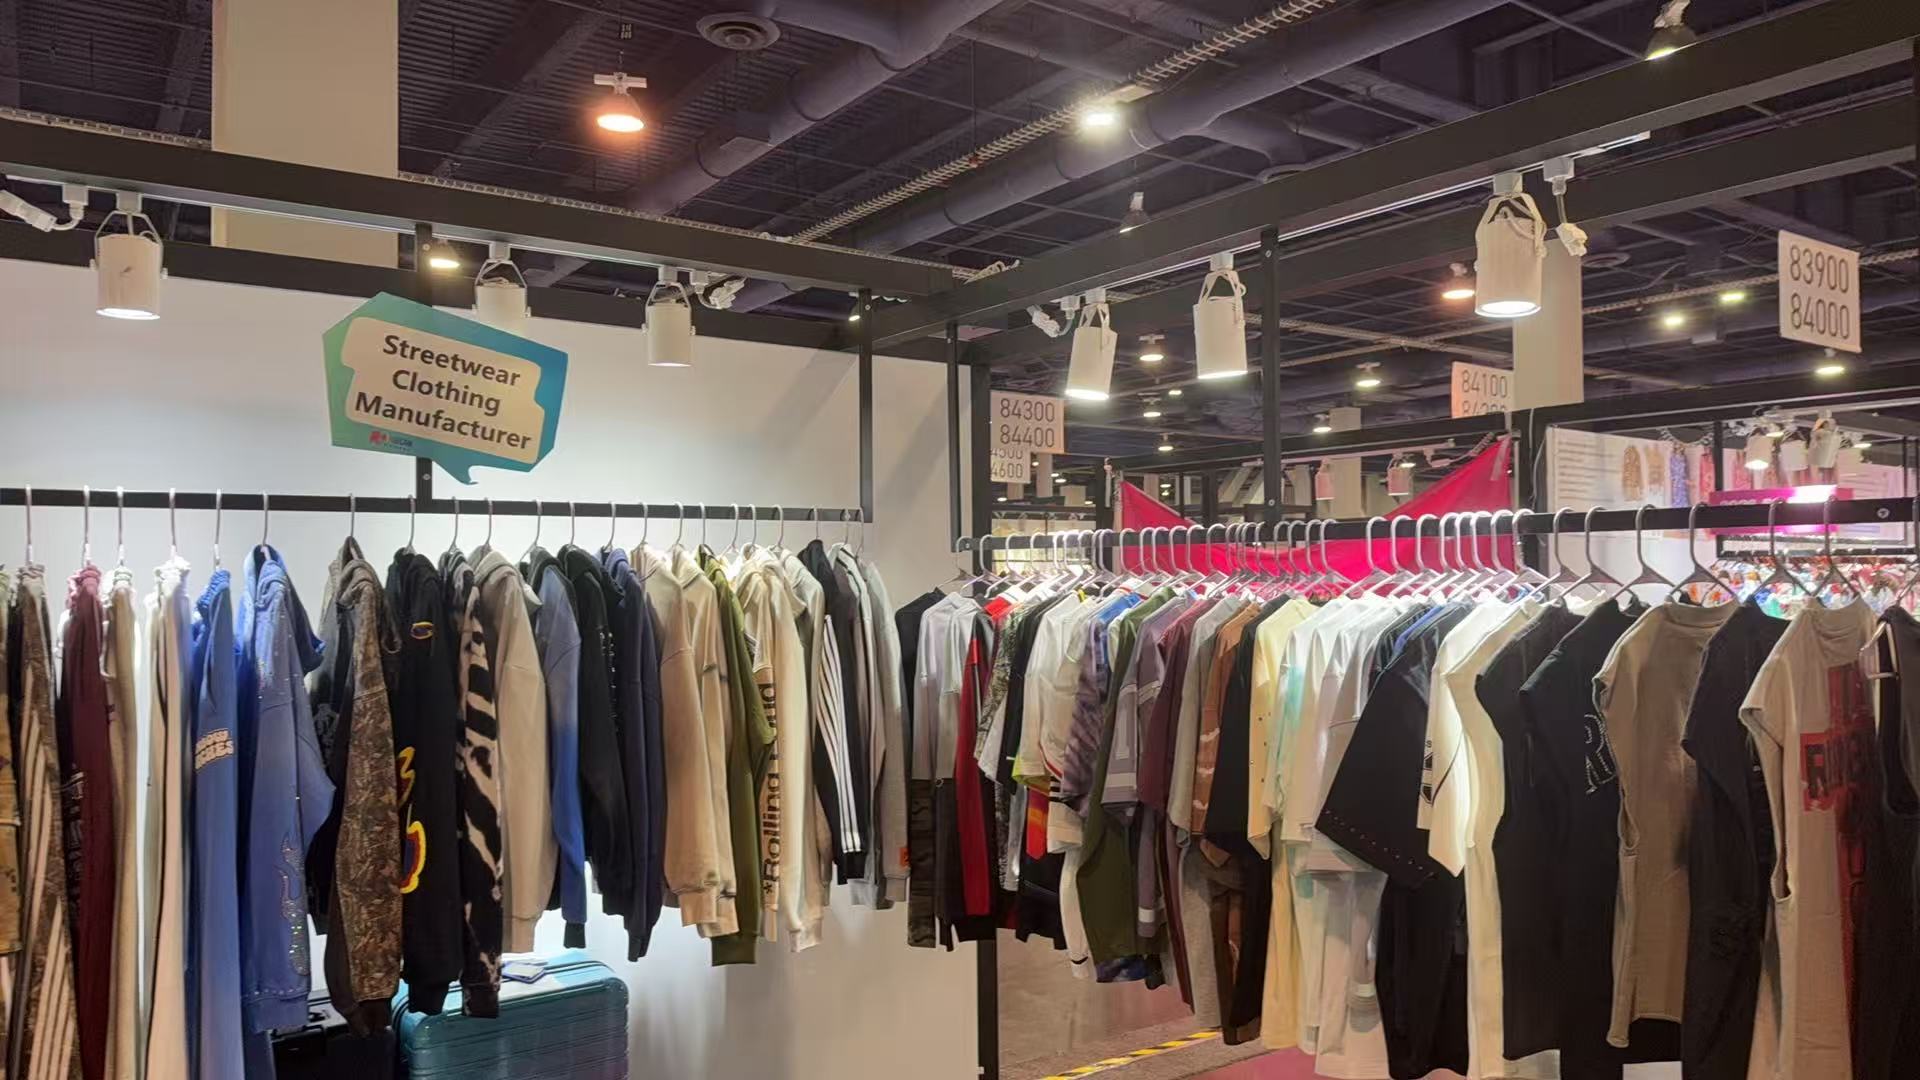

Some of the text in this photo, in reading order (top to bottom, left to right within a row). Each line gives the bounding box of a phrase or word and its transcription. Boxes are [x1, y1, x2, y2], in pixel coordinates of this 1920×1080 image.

[1790, 245, 1849, 293] 83900
[1791, 292, 1849, 340] 84000
[382, 334, 521, 387] Streetwear
[1461, 369, 1508, 398] 84100
[391, 369, 501, 417] Clothing
[999, 398, 1055, 422] 84300
[353, 391, 532, 450] Manufacturer
[999, 424, 1055, 448] 84400
[990, 461, 1023, 479] 4600
